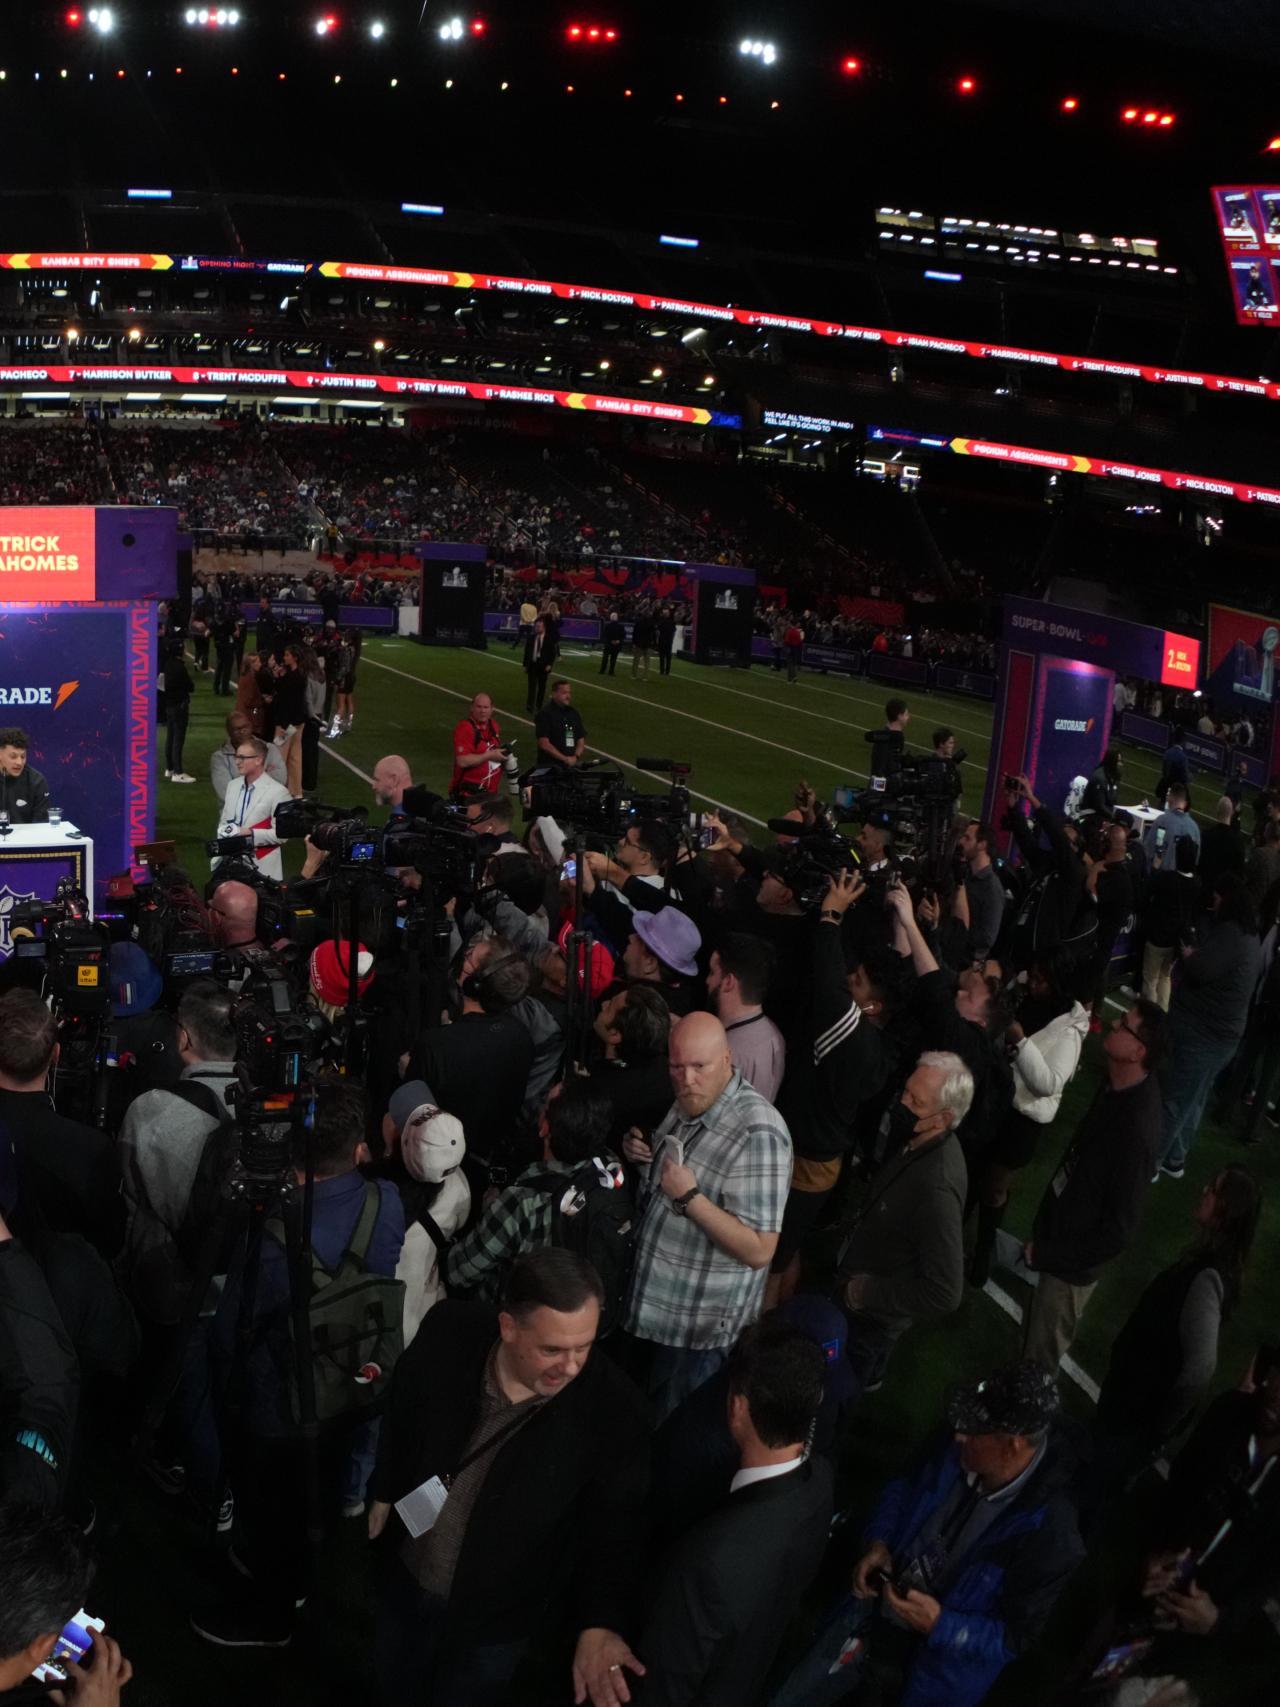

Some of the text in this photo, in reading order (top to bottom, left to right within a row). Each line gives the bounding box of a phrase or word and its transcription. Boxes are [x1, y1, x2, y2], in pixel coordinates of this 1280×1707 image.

[0, 370, 47, 379] PACHECO
[83, 370, 133, 379] HARRISON
[135, 370, 171, 380] BUTKER
[207, 372, 237, 381] TRENT
[238, 373, 286, 383] MCDUFFIE
[321, 377, 354, 386] JUSTIN
[355, 379, 376, 388] REID
[414, 382, 436, 392] TREY
[437, 384, 466, 394] SMITH
[500, 390, 533, 400] RASHEE
[534, 393, 554, 402] RICE
[596, 400, 683, 418] KANSAS CITY CHIEFS
[974, 444, 1068, 466] PODIUM ASSIGNMENTS
[1111, 466, 1135, 477] CHRIS
[1134, 471, 1161, 482] JONES
[1186, 480, 1205, 489] NICK
[1205, 482, 1233, 494] BOLTON
[1257, 492, 1280, 503] PATRIC
[1011, 615, 1045, 632] SUPER
[1049, 624, 1083, 642] BOWL
[1054, 719, 1087, 732] GATORADE
